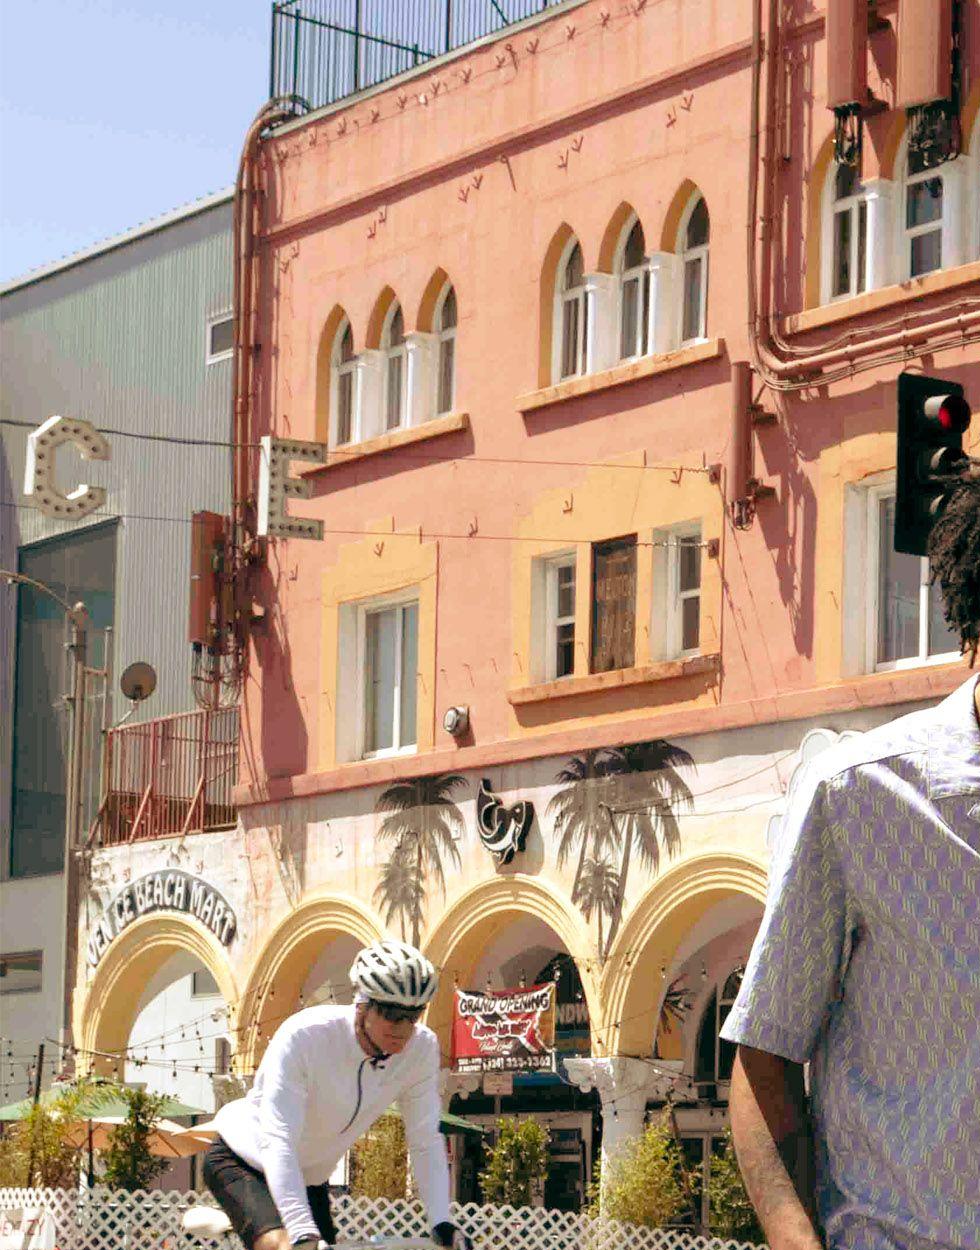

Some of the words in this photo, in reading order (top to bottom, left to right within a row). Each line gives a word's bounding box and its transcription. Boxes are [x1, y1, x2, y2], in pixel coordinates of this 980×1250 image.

[134, 873, 186, 912] BEACH
[189, 880, 236, 945] MART
[459, 997, 496, 1014] GRAND
[500, 992, 550, 1012] OPENING
